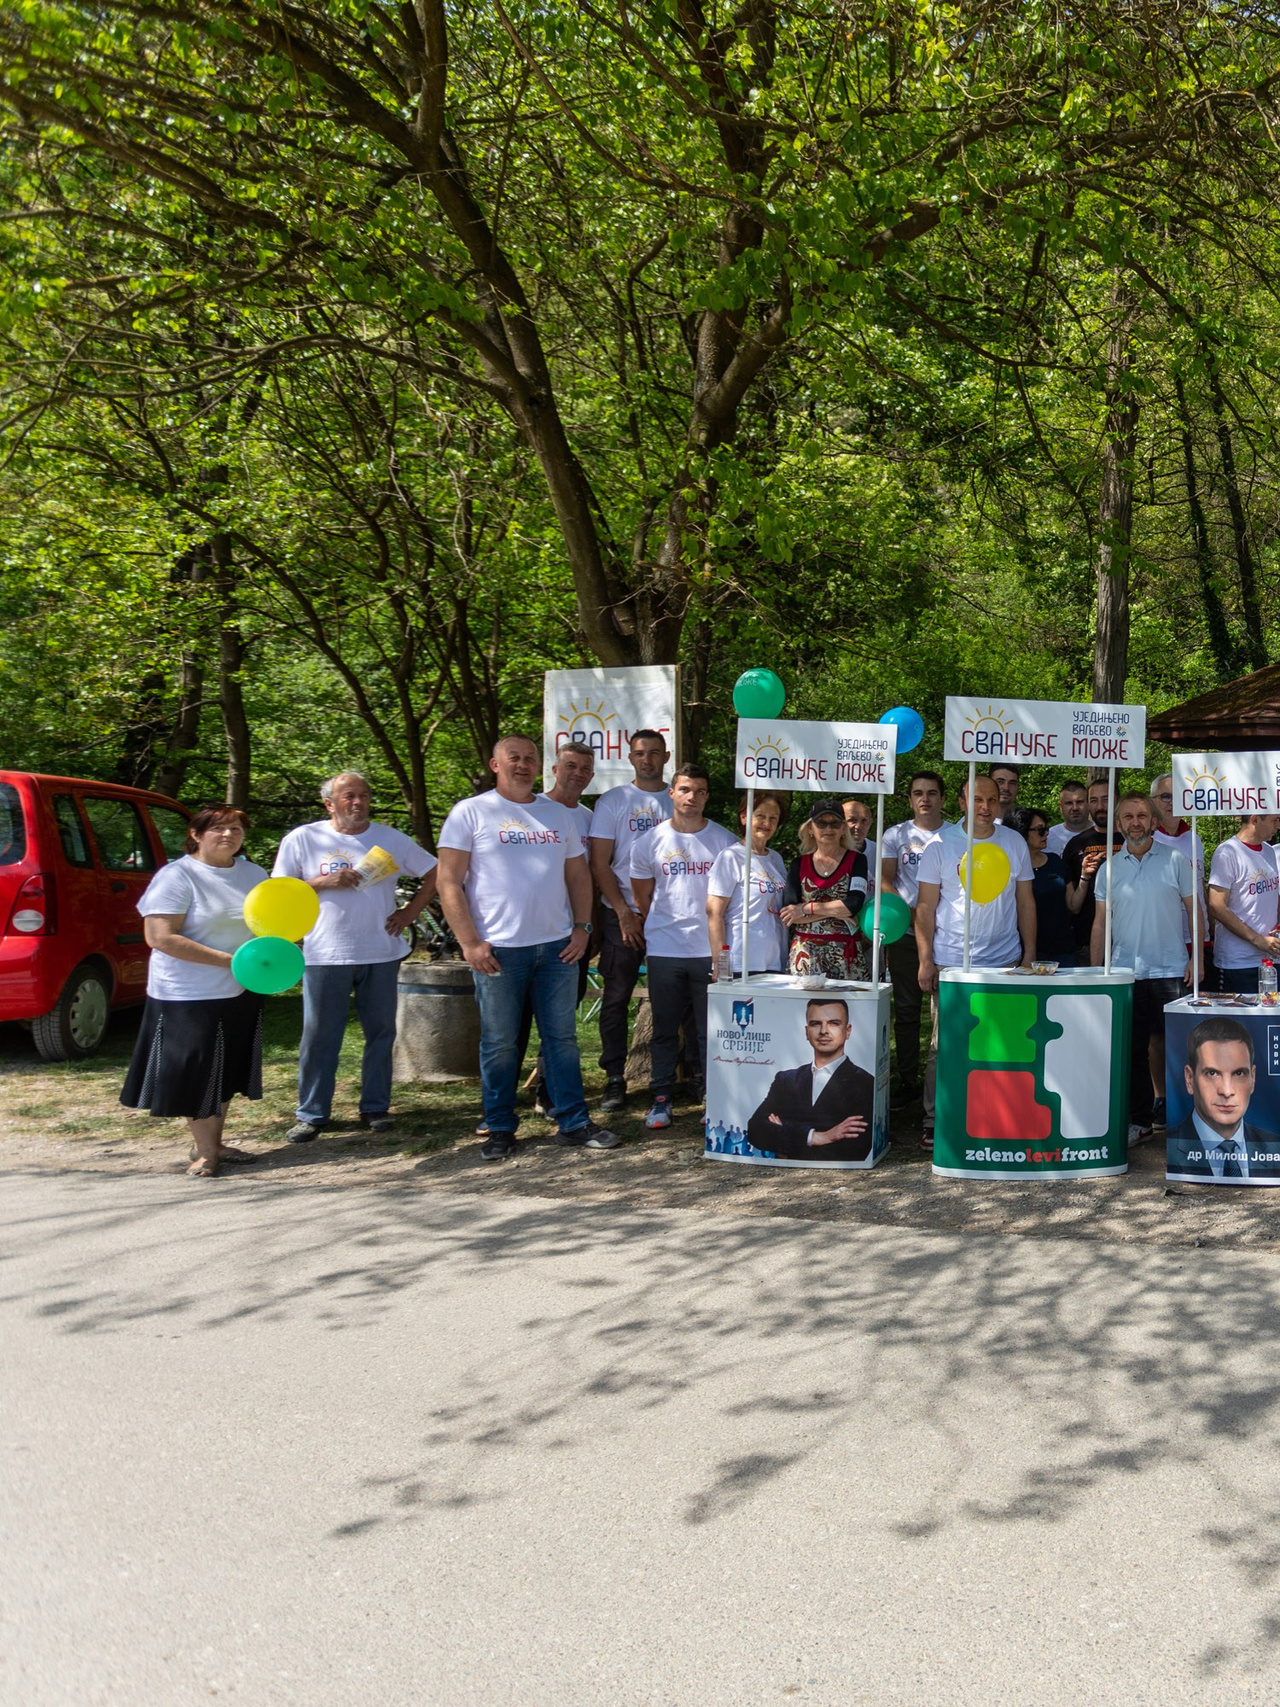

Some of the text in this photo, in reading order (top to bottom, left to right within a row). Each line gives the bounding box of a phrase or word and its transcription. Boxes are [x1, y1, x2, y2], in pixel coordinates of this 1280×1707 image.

[1073, 711, 1130, 724] УЈЕДИЊЕНО
[1072, 724, 1112, 736] ВАЉЕВО
[837, 738, 888, 750] УЈЕДИЊЕНО
[962, 730, 1129, 760] СВАНУЋЕ МОЖЕ
[837, 750, 872, 761] ВАЉЕВО
[744, 756, 886, 783] СВАНУЋЕ МОЖЕ
[1182, 787, 1267, 811] СВАНУЋЕ
[498, 830, 561, 845] СВАНУЋЕ
[661, 861, 714, 876] СВАНУЋ
[716, 1029, 772, 1043] НОВО ЛИЦЕ
[722, 1039, 765, 1054] СРБИЈЕ
[965, 1146, 1109, 1163] zelenolevifront
[1187, 1152, 1202, 1161] др
[1205, 1149, 1248, 1161] Милош
